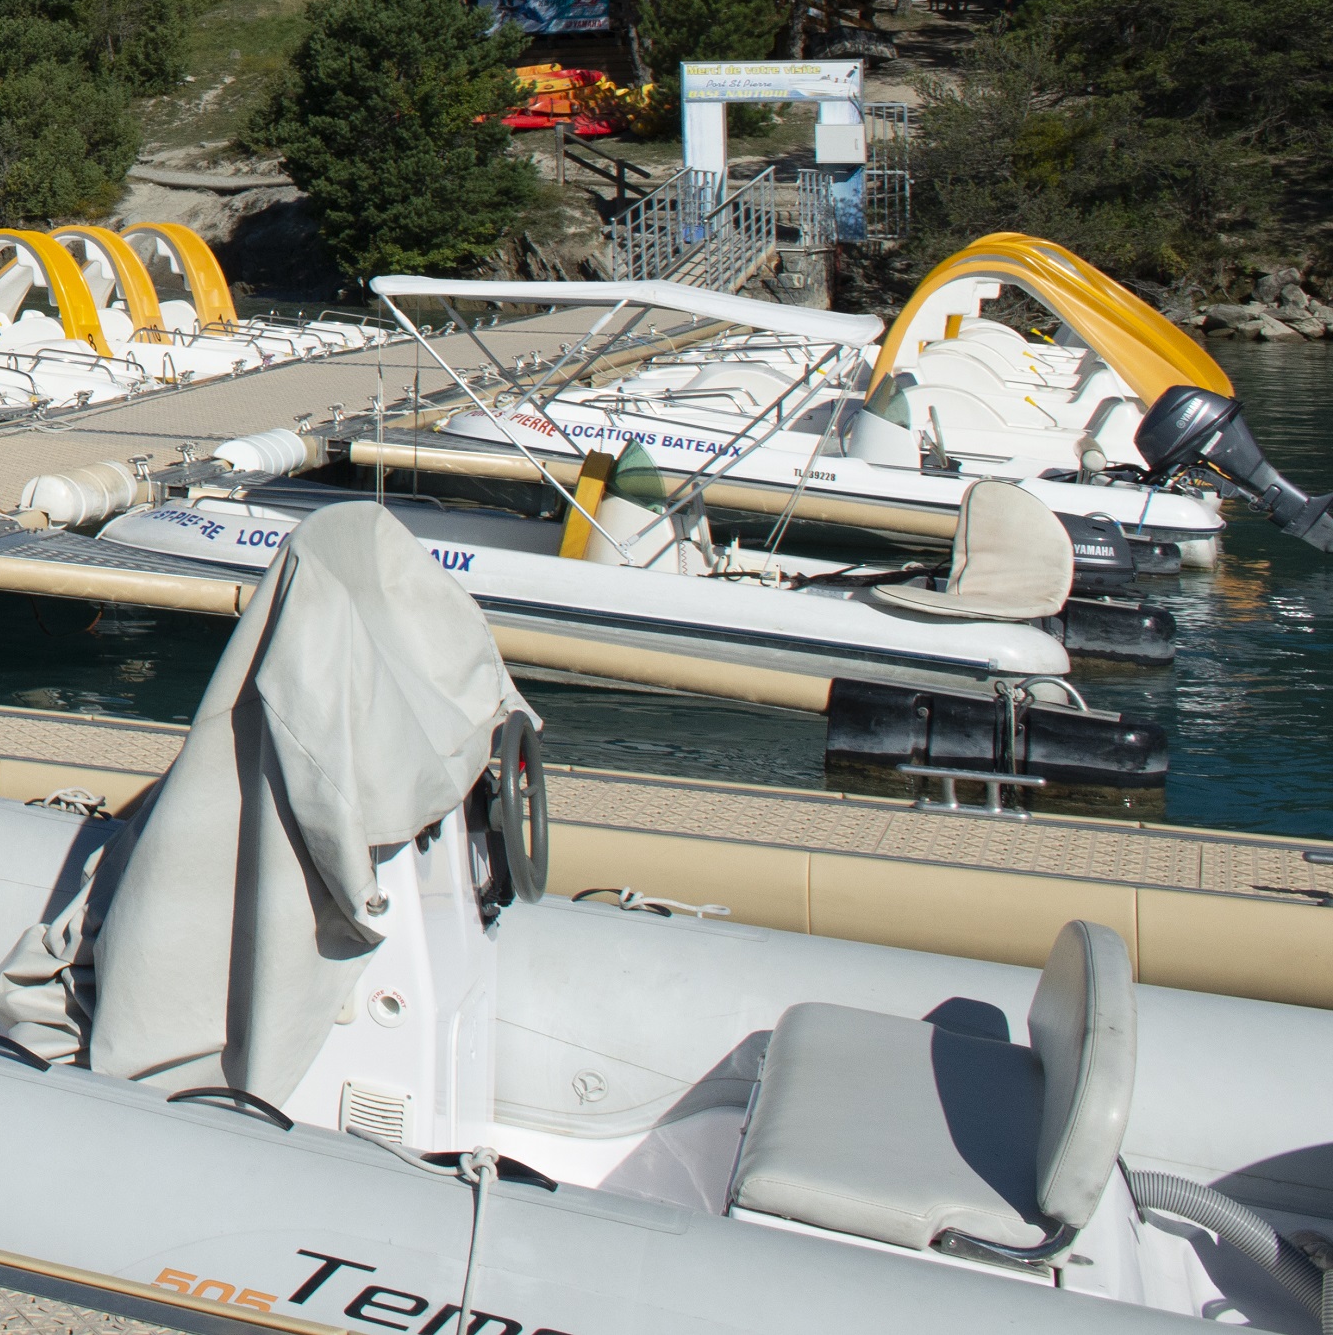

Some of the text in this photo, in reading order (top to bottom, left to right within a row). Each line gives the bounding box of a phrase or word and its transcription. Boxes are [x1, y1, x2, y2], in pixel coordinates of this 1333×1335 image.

[686, 64, 821, 75] Merci de votre visite
[706, 79, 773, 87] Port St Pierre
[88, 333, 97, 352] 8
[149, 323, 162, 343] 10
[1180, 397, 1204, 422] YAMAHA
[509, 413, 557, 437] PIERRE
[563, 424, 657, 446] LOCATIONS
[661, 435, 743, 457] BATEAUX
[1073, 543, 1115, 557] YAMAHA
[371, 989, 406, 1009] FIRE PORT
[288, 1248, 573, 1335] Tem
